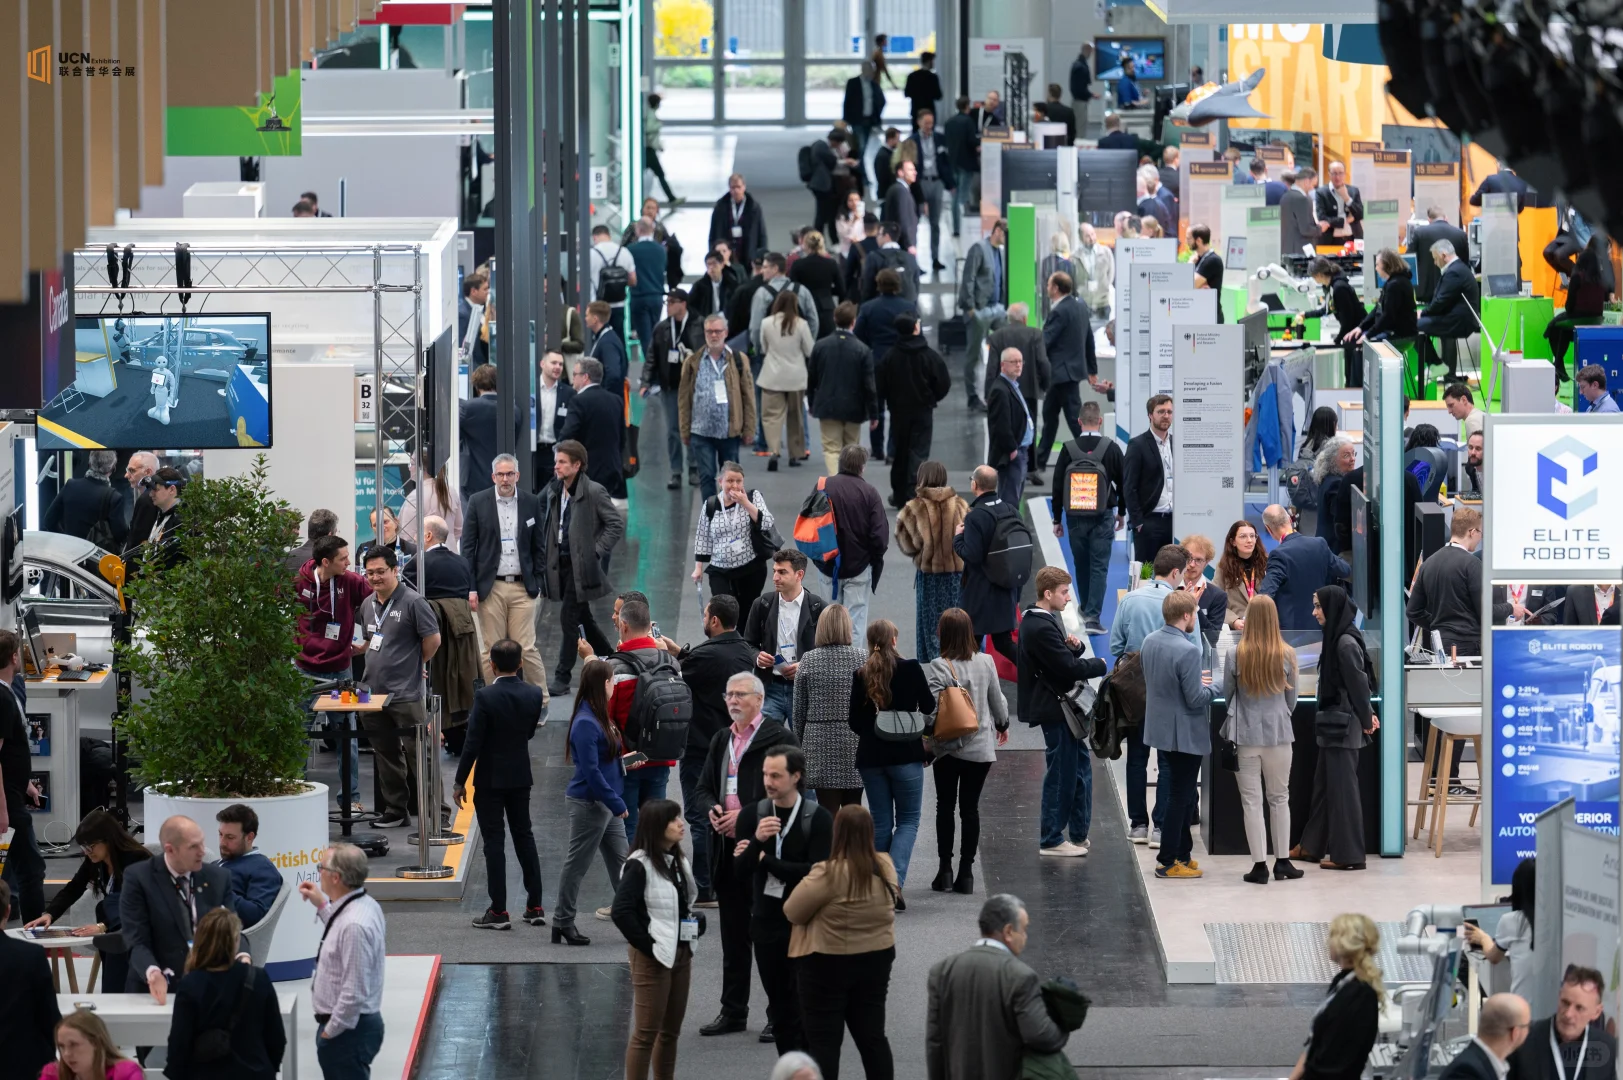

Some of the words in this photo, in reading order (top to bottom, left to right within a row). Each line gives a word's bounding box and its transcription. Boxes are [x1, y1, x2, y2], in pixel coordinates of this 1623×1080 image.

[49, 276, 69, 334] Canada
[361, 385, 371, 398] B
[363, 476, 375, 485] für
[1534, 529, 1600, 541] ELITE
[1523, 547, 1610, 560] ROBOTS
[1519, 813, 1538, 824] YO
[1574, 813, 1612, 824] ERIOR
